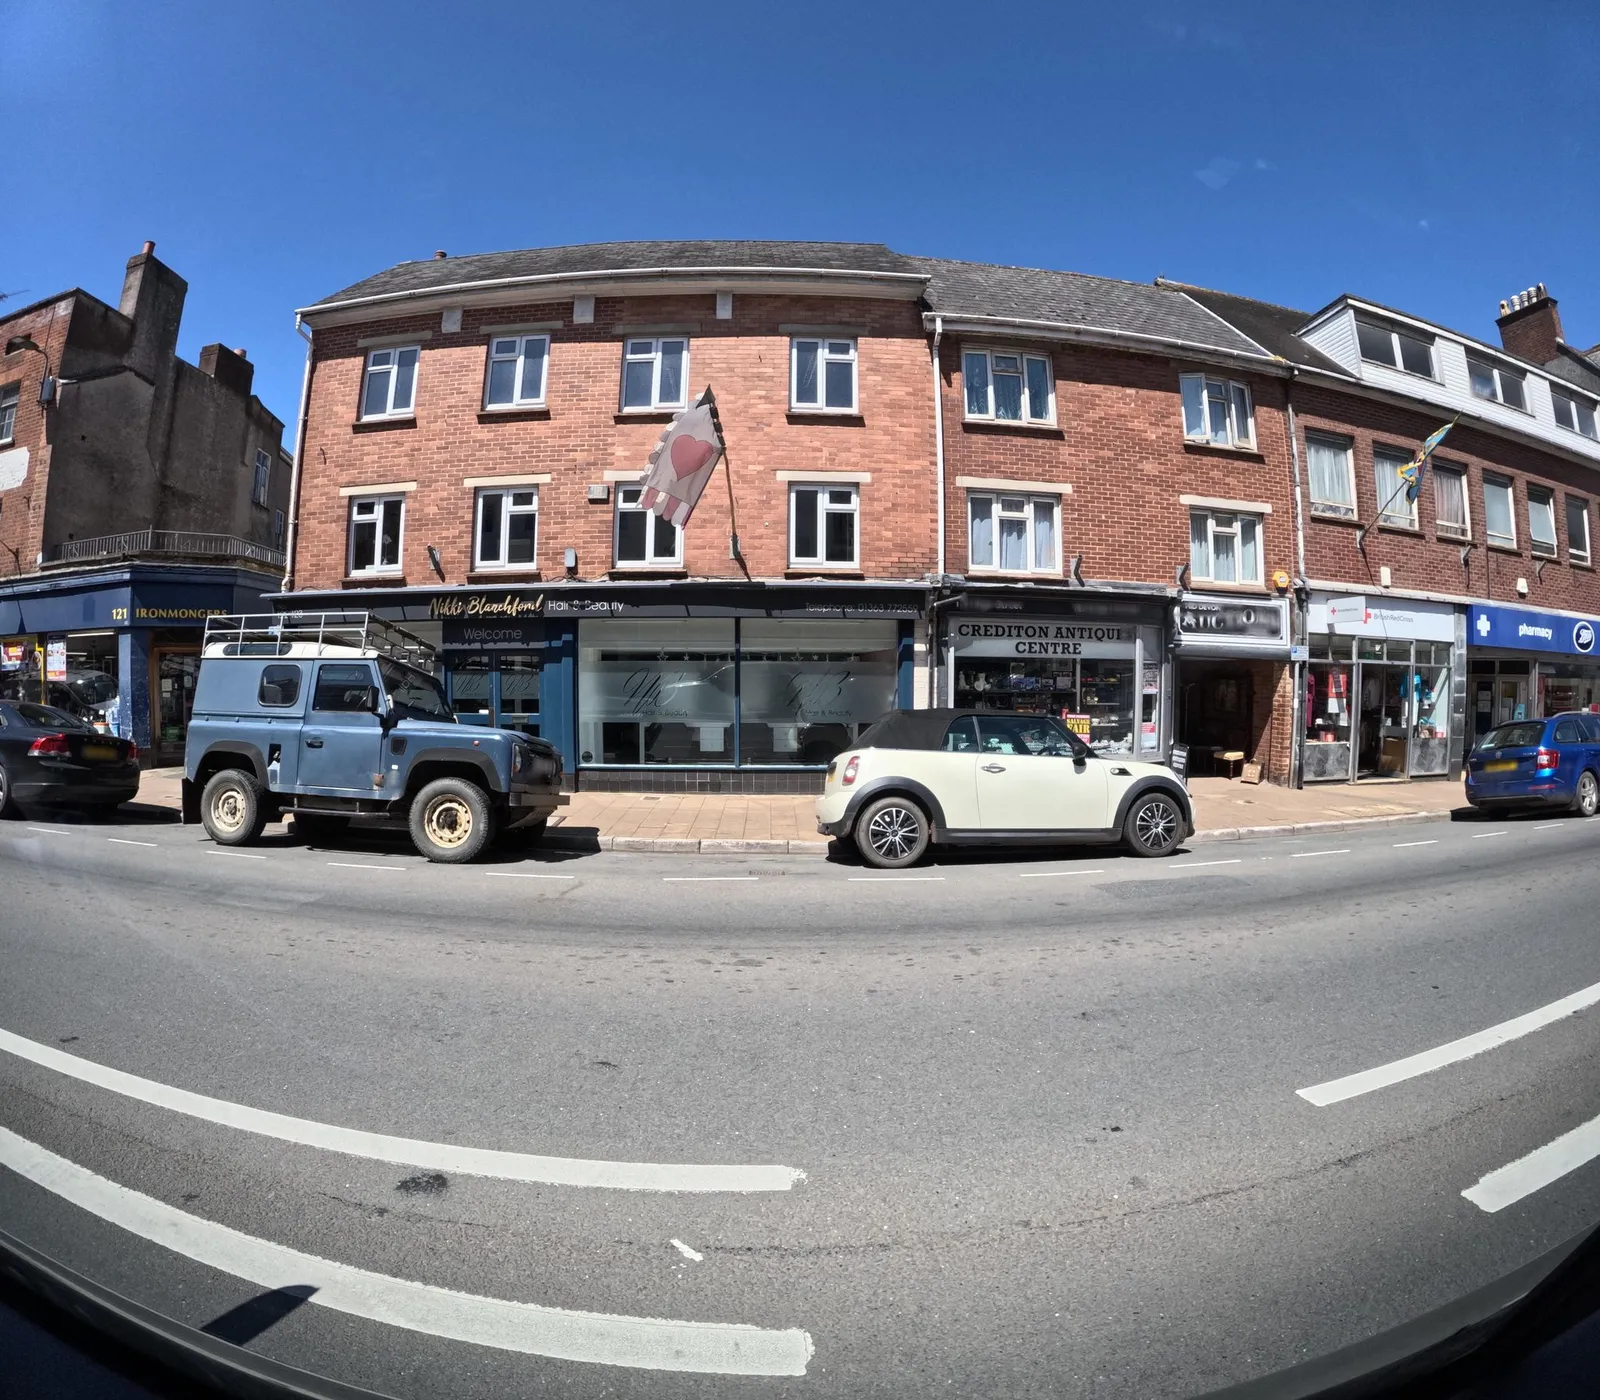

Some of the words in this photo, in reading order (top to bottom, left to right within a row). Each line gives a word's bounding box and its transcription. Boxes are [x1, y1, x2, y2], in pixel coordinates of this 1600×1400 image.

[428, 596, 463, 616] Nikki
[467, 594, 544, 616] Blanchford
[548, 600, 569, 611] Hair
[112, 608, 127, 620] 121
[135, 608, 228, 618] IRONMONGERS
[463, 628, 523, 640] Welcome
[957, 624, 1050, 639] CREDITON
[1054, 626, 1136, 642] ANTIQU
[1518, 622, 1553, 641] pharmacy
[1014, 641, 1083, 655] CENTRE
